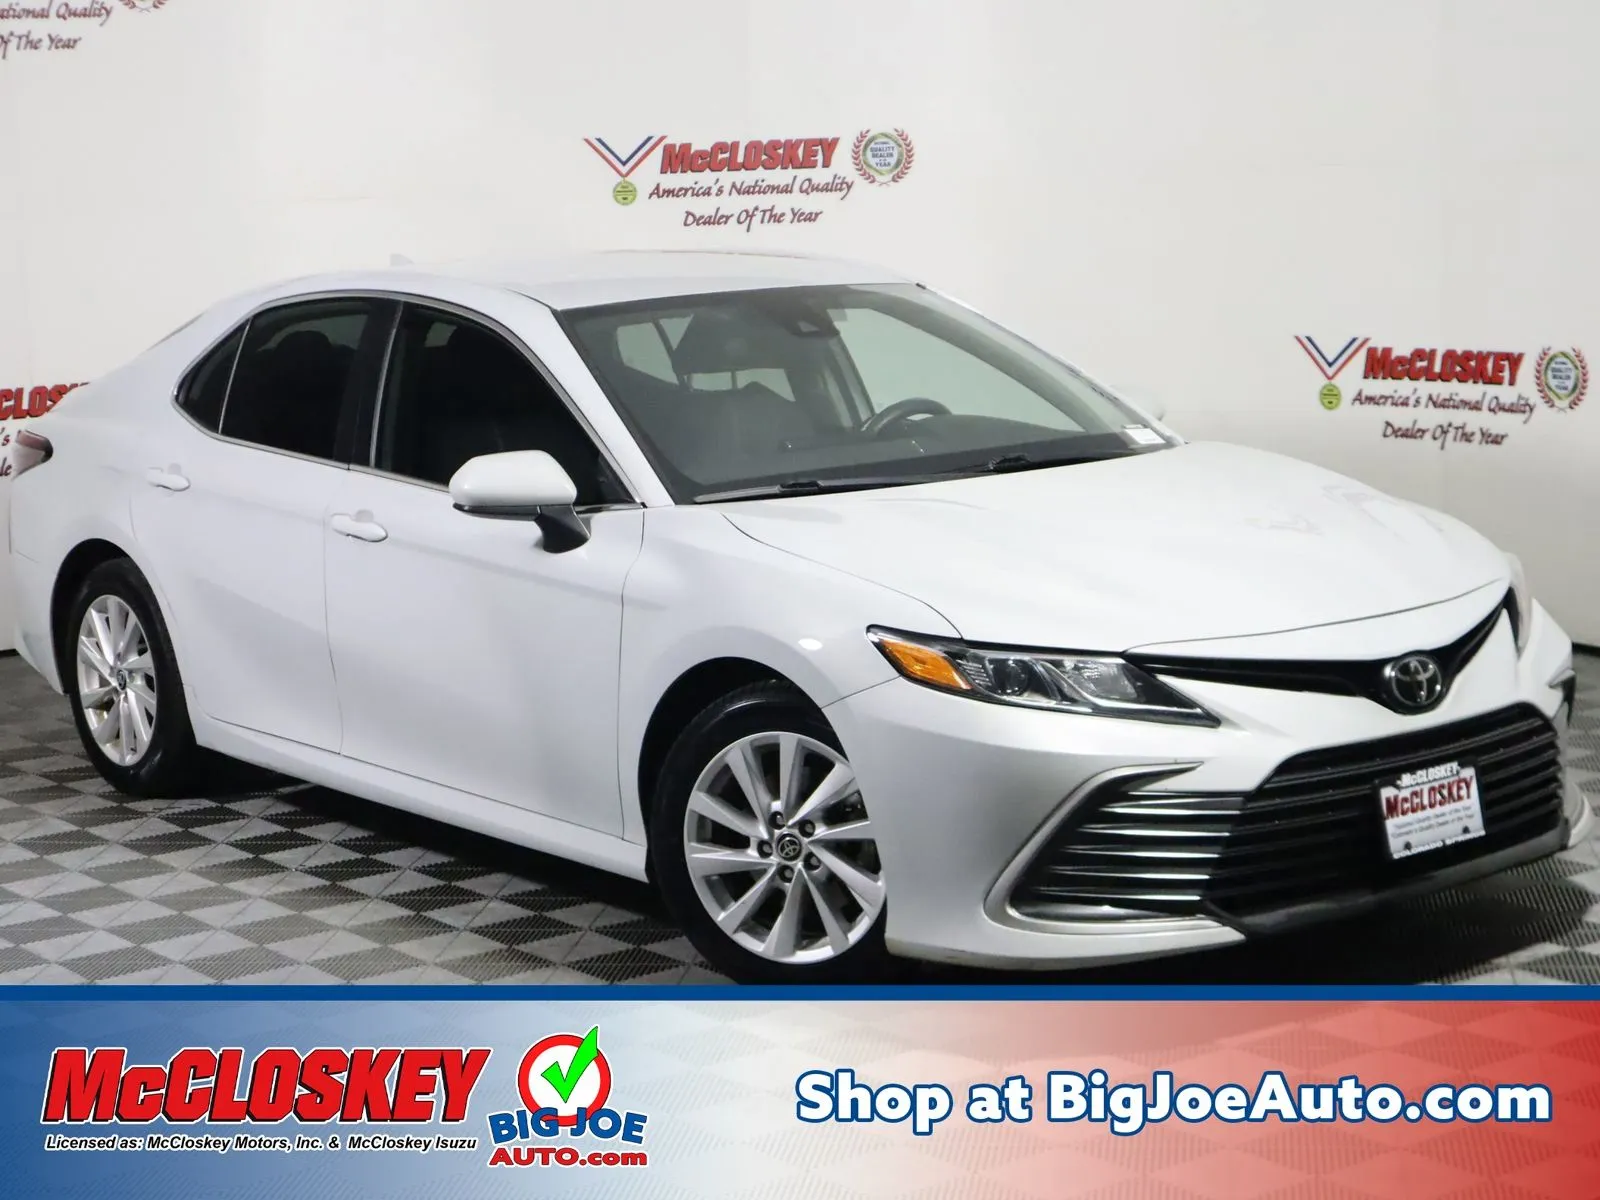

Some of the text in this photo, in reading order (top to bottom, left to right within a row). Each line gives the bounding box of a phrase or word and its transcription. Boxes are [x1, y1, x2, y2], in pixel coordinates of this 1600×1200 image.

[0, 0, 113, 26] ational Quality
[13, 29, 43, 50] The
[47, 33, 82, 50] Year
[660, 136, 840, 174] McCLOSKEY
[648, 178, 724, 199] America's
[728, 175, 797, 196] National
[799, 173, 854, 200] Quality
[682, 205, 823, 233] Dealer Of The Year
[1363, 346, 1524, 386] McCLOSKEY
[1351, 388, 1422, 408] America's
[1425, 392, 1487, 411] National
[1488, 393, 1536, 424] Quality
[1382, 419, 1508, 450] Dealer Of The Year
[1385, 776, 1473, 819] McCLOSKEY
